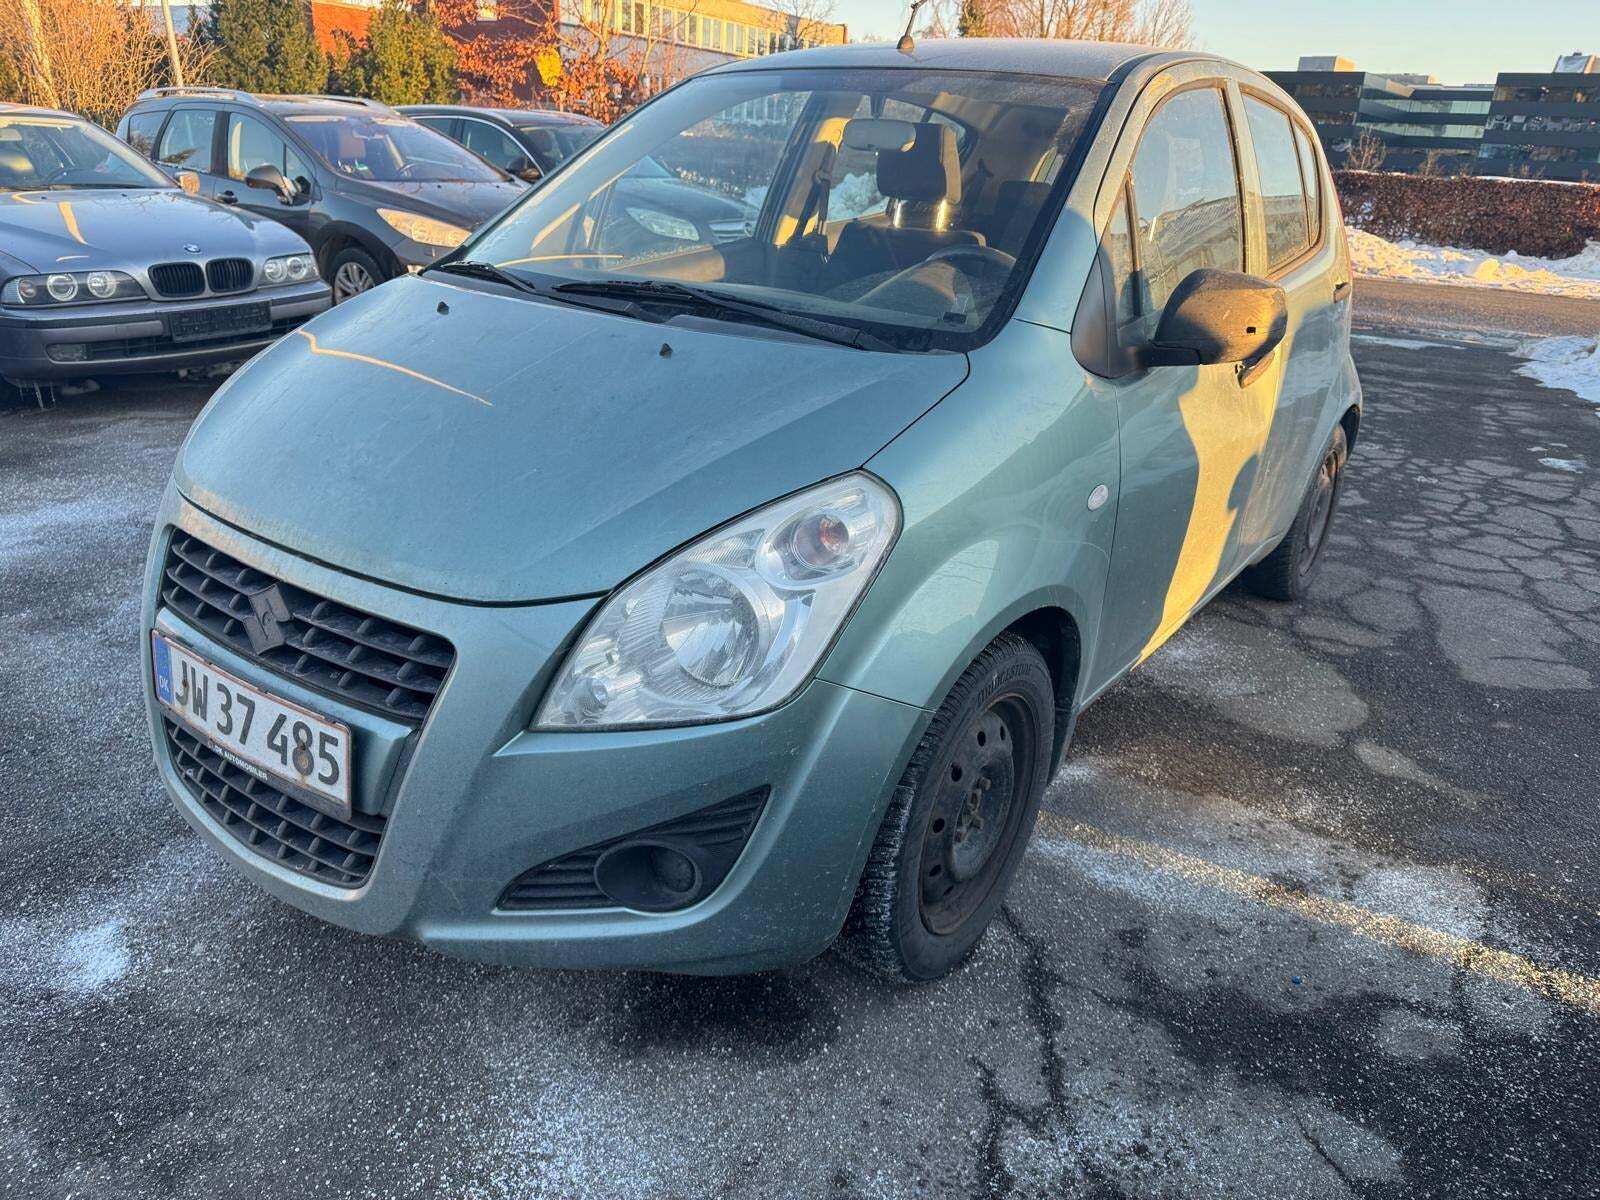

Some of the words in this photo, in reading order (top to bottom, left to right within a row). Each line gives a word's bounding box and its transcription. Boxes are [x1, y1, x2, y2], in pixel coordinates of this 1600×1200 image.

[160, 675, 169, 692] DK
[175, 660, 208, 722] JW
[216, 682, 256, 745] 37
[267, 713, 340, 786] 485
